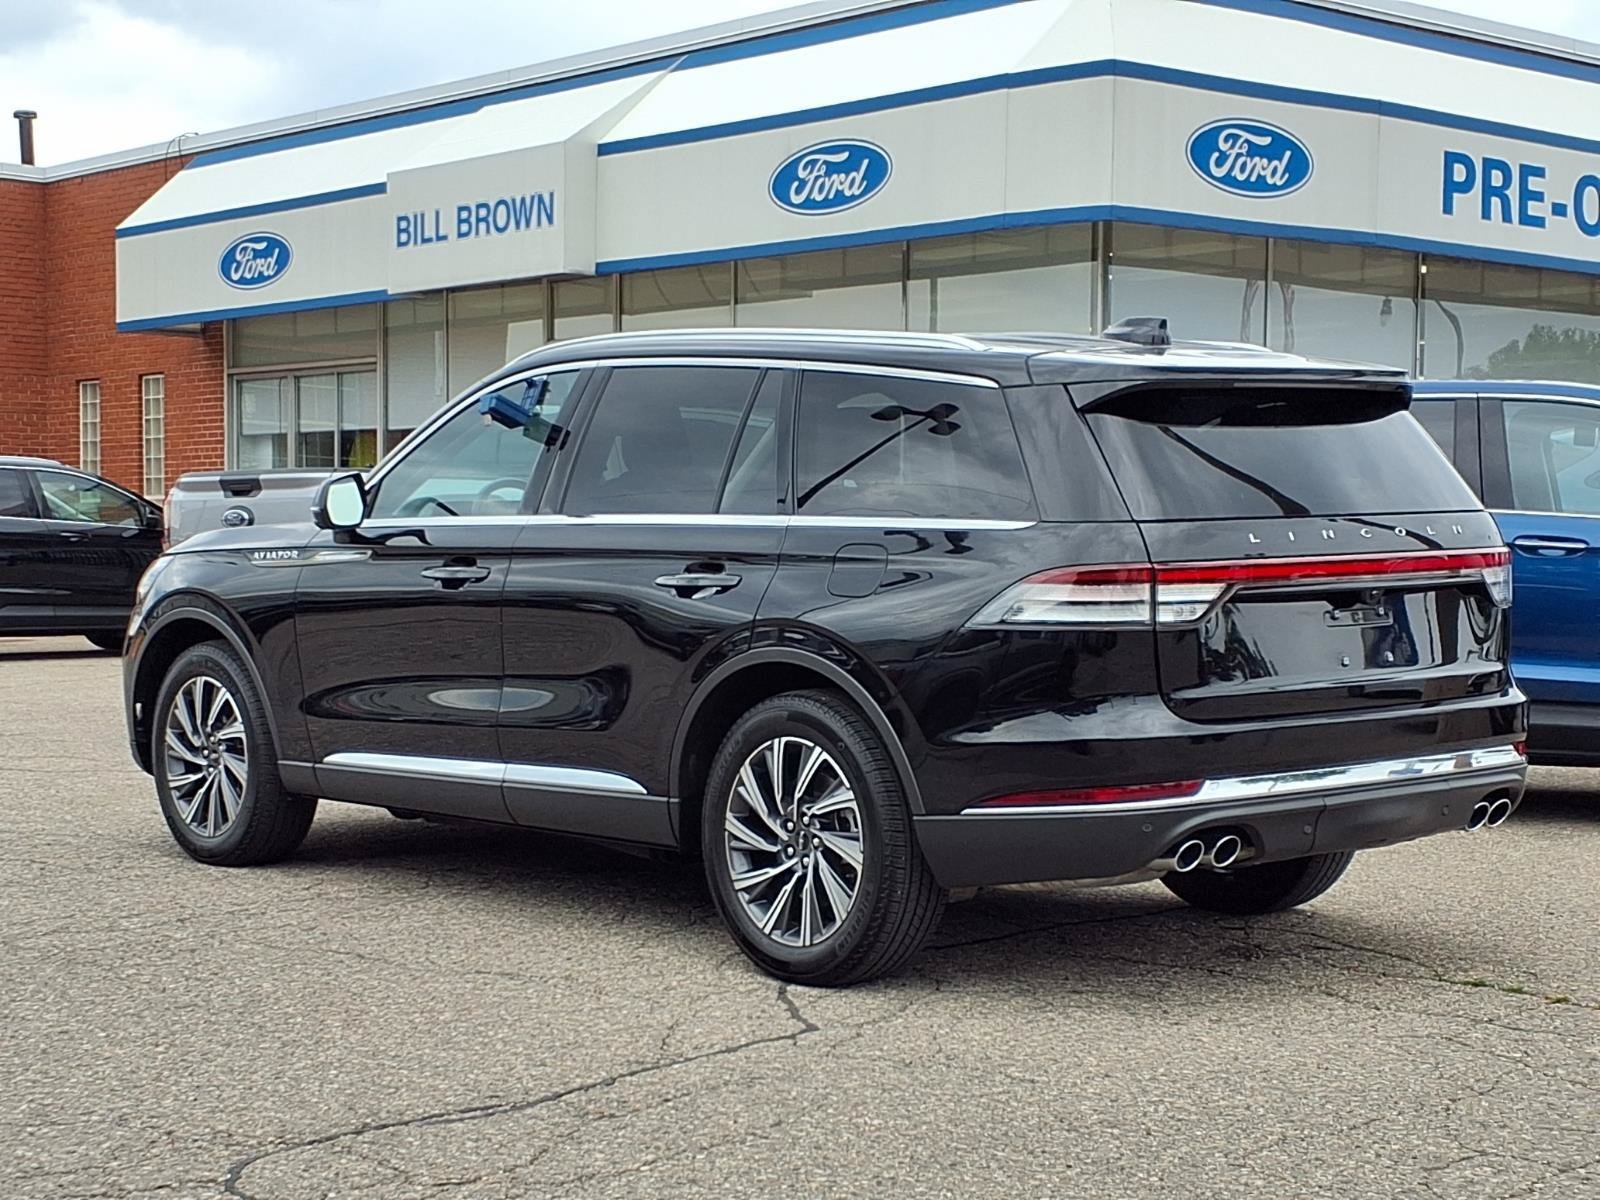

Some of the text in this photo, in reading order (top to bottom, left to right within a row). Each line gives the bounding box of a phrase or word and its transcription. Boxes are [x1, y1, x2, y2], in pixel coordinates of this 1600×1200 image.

[790, 151, 869, 204] Ford
[1209, 128, 1291, 186] Ford
[396, 190, 554, 248] BILL BROWN
[231, 242, 279, 281] Ford
[253, 550, 299, 560] AVIATOR
[1249, 525, 1463, 543] LINCOLN
